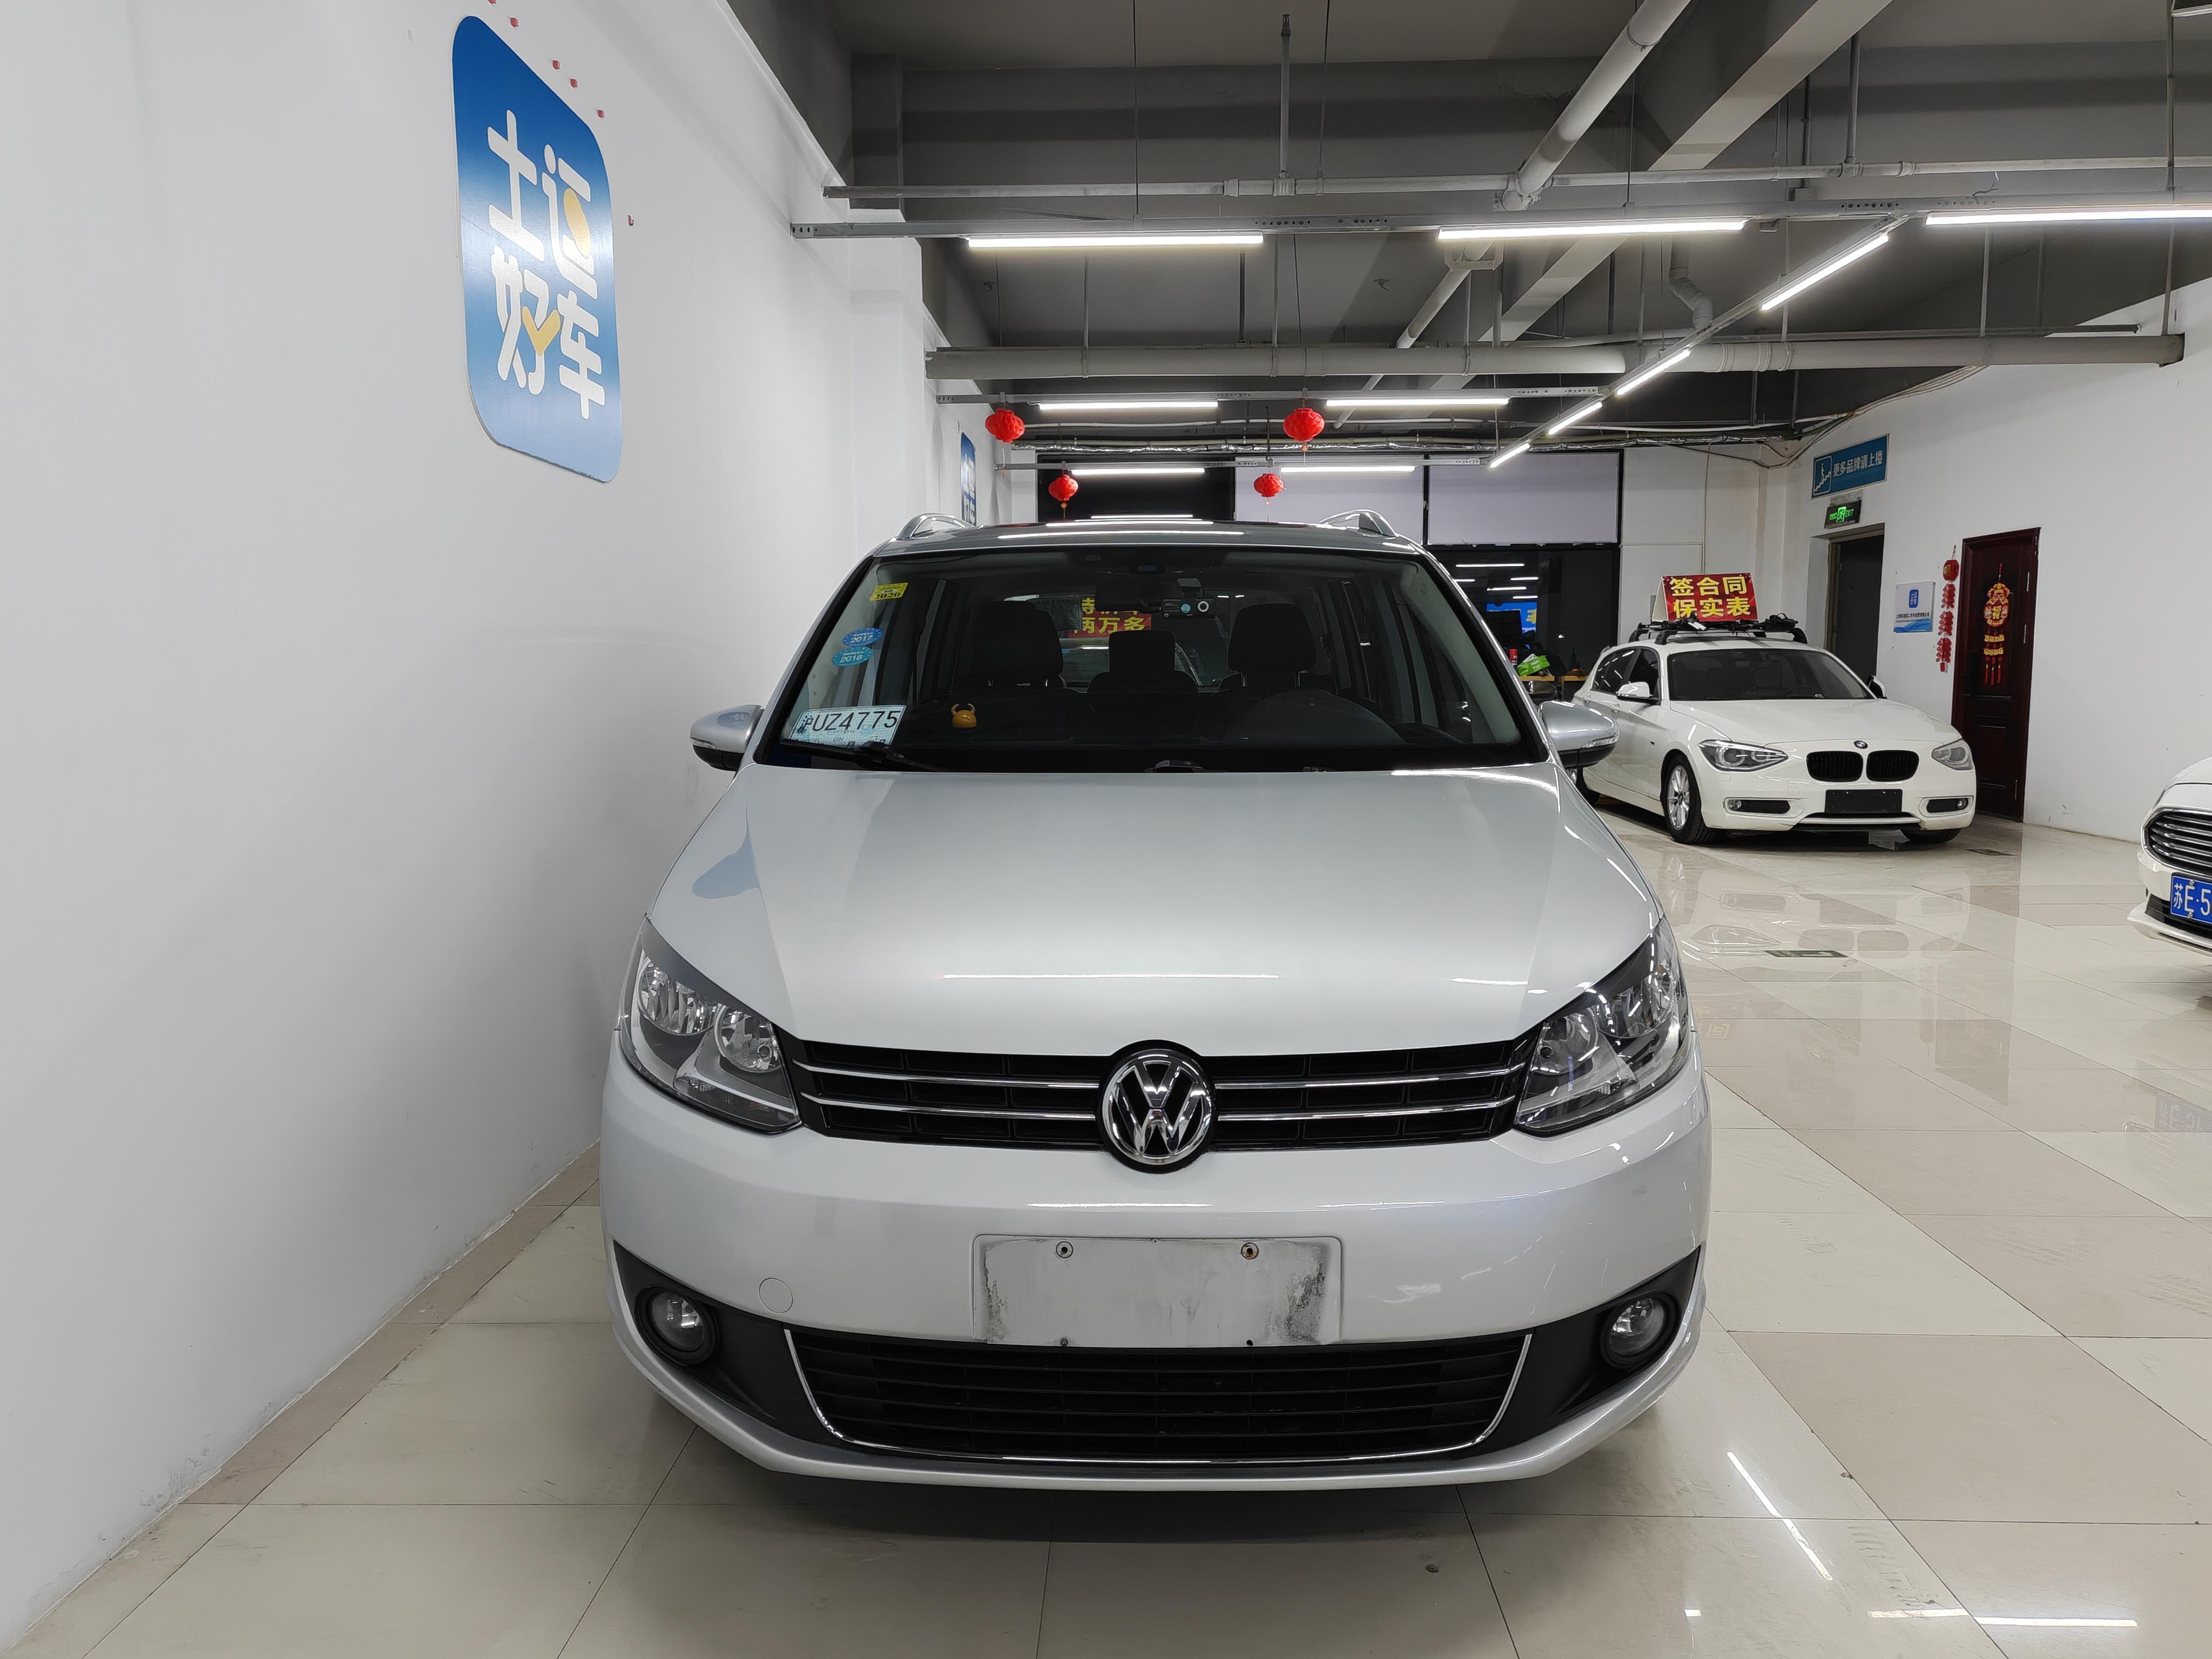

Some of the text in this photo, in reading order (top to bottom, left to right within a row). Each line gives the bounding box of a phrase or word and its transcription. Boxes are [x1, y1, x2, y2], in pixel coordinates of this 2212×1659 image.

[490, 245, 605, 421] 好车
[1833, 450, 1883, 477] 更多品牌请上楼
[1669, 576, 1748, 597] 签合同
[1673, 597, 1751, 619] 保实表
[850, 635, 874, 643] 2017
[839, 654, 863, 663] 2018
[797, 710, 901, 733] 沪UZ4775
